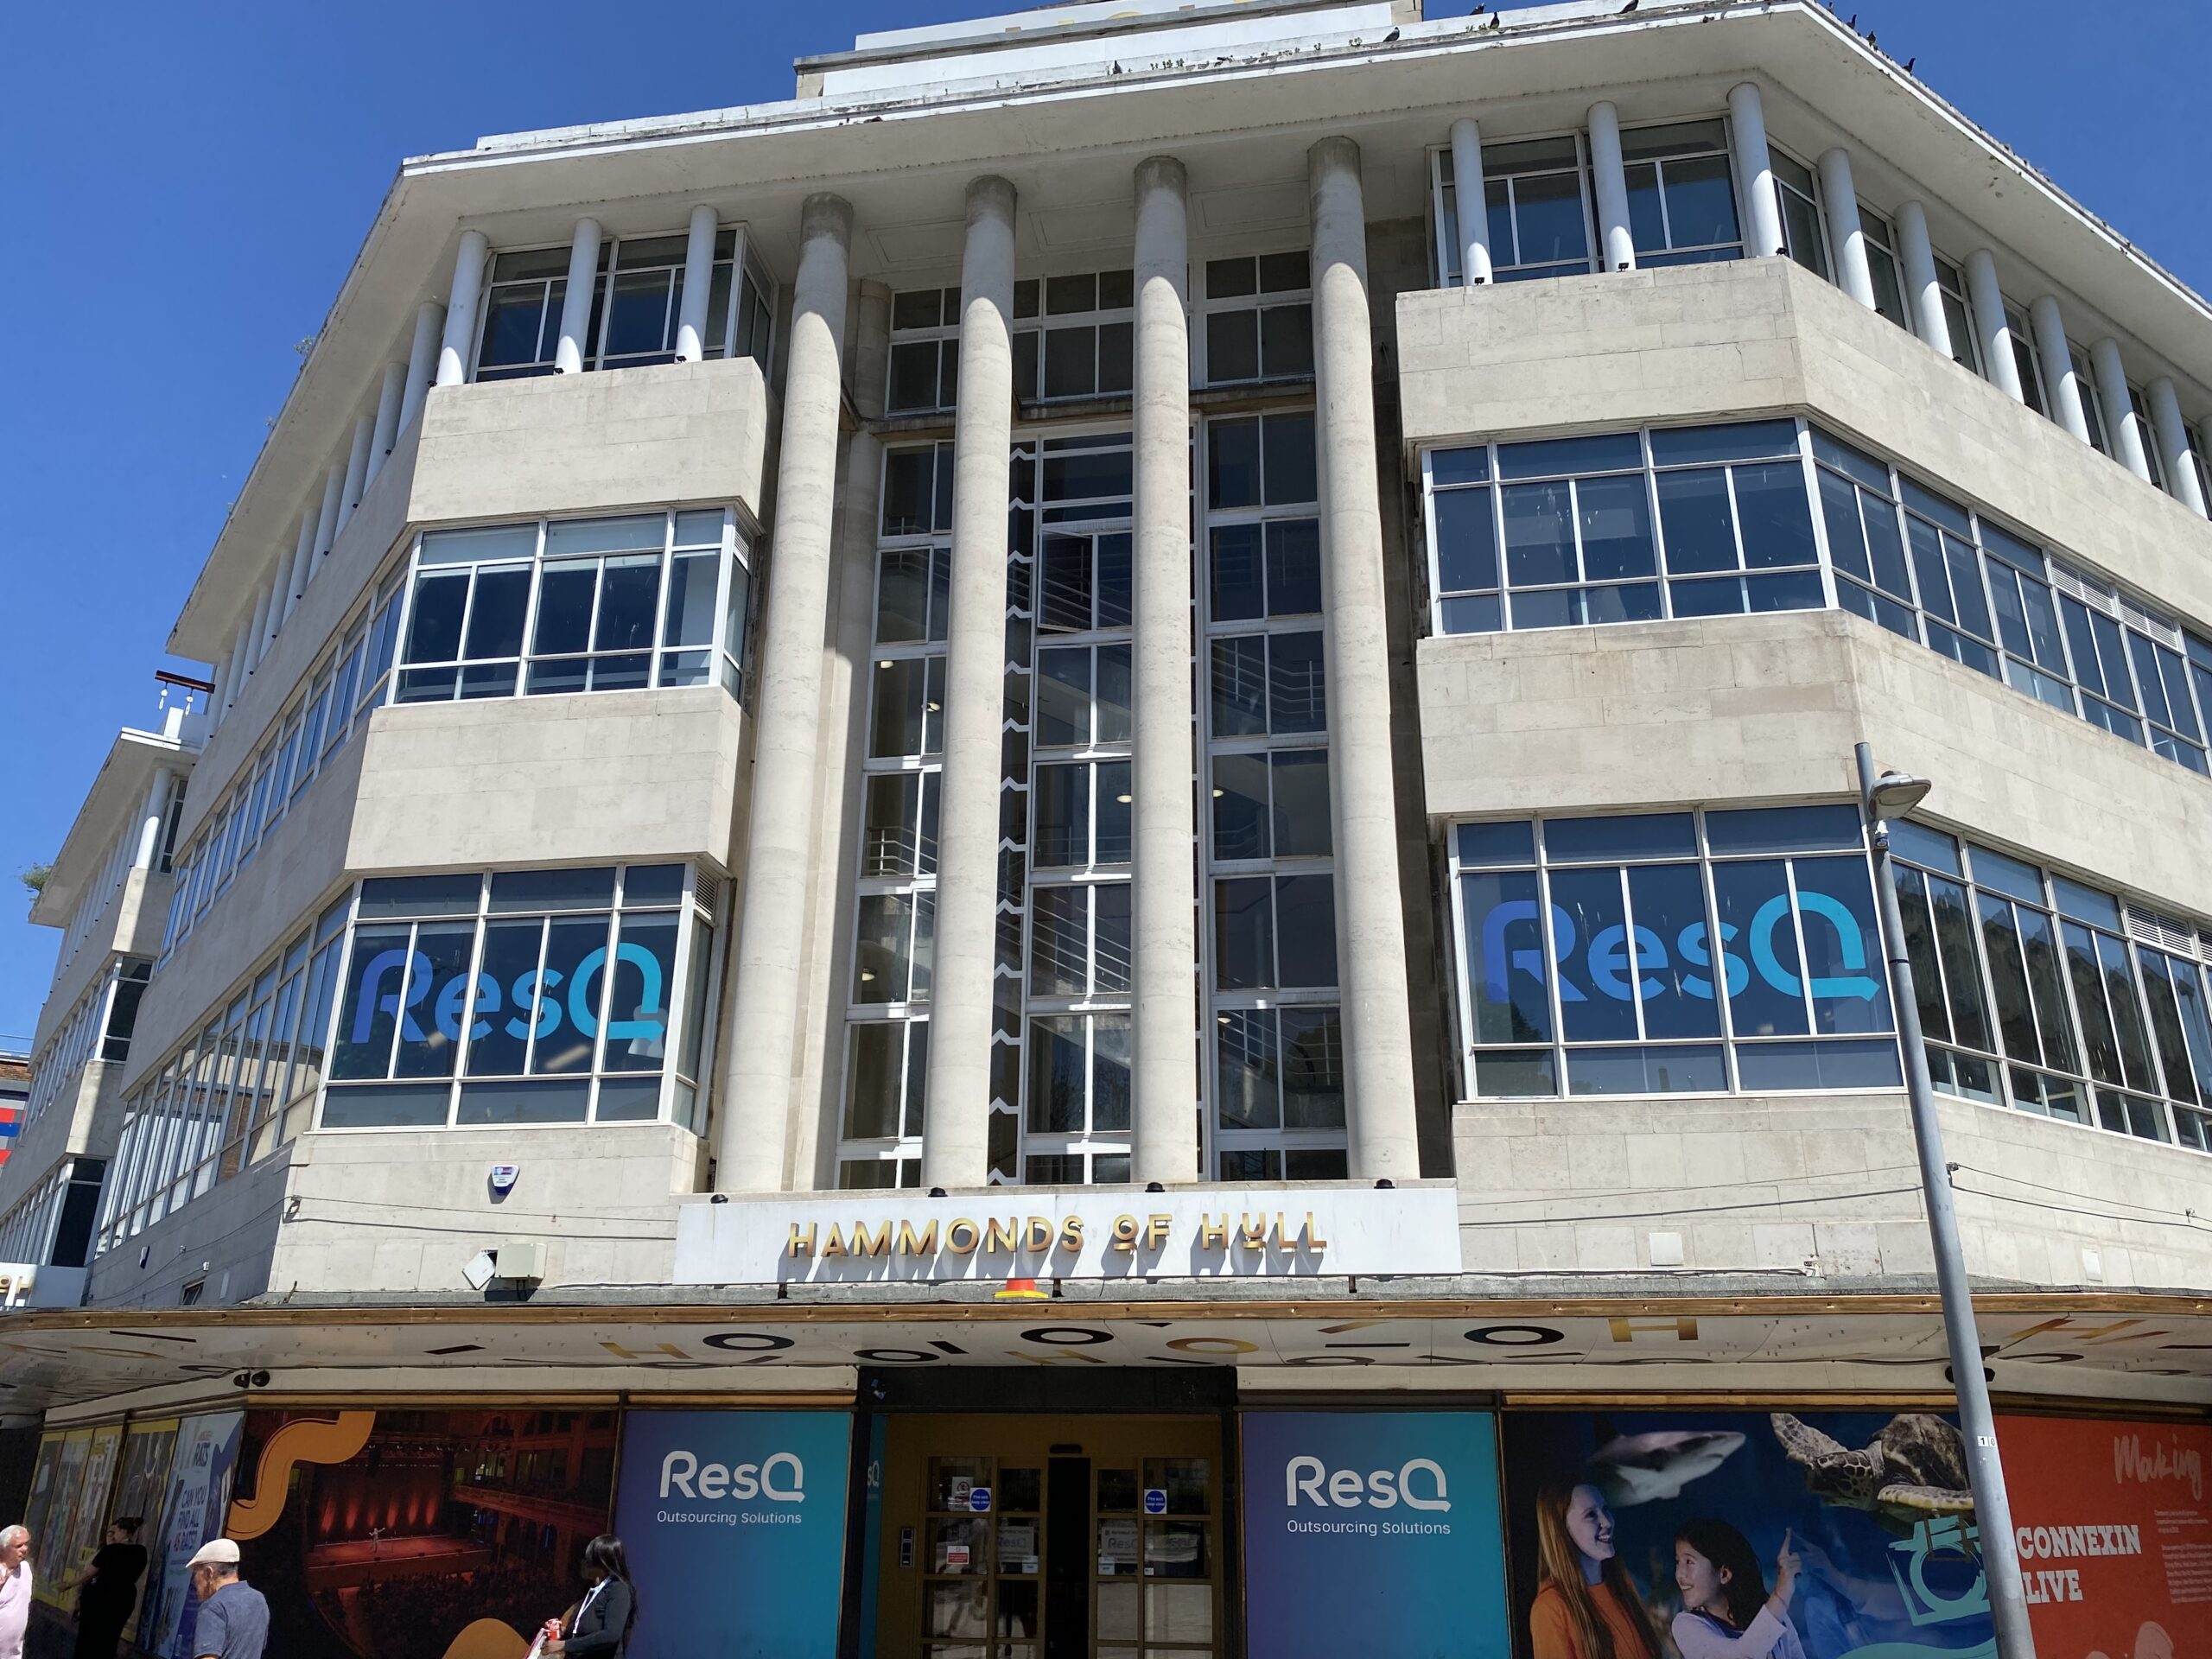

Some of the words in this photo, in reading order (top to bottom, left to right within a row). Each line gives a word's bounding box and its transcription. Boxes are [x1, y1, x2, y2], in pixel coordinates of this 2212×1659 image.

[1482, 891, 1881, 1003] ResQ
[352, 942, 665, 1045] ResQ
[788, 1214, 1084, 1258] HAMMONDS
[1113, 1212, 1173, 1253] OF
[1202, 1211, 1328, 1250] HULL
[659, 1450, 805, 1503] ResQ
[1286, 1456, 1452, 1513] ResQ
[2113, 1433, 2202, 1501] Making
[181, 1488, 194, 1509] CAN
[193, 1485, 207, 1507] YOU
[657, 1510, 737, 1526] Outsourcing
[741, 1512, 802, 1524] Solutions
[1287, 1519, 1377, 1537] Outsourcing
[1382, 1522, 1451, 1535] Solutions
[2015, 1524, 2142, 1560] CONNEXIN
[2022, 1569, 2083, 1605] LIVE
